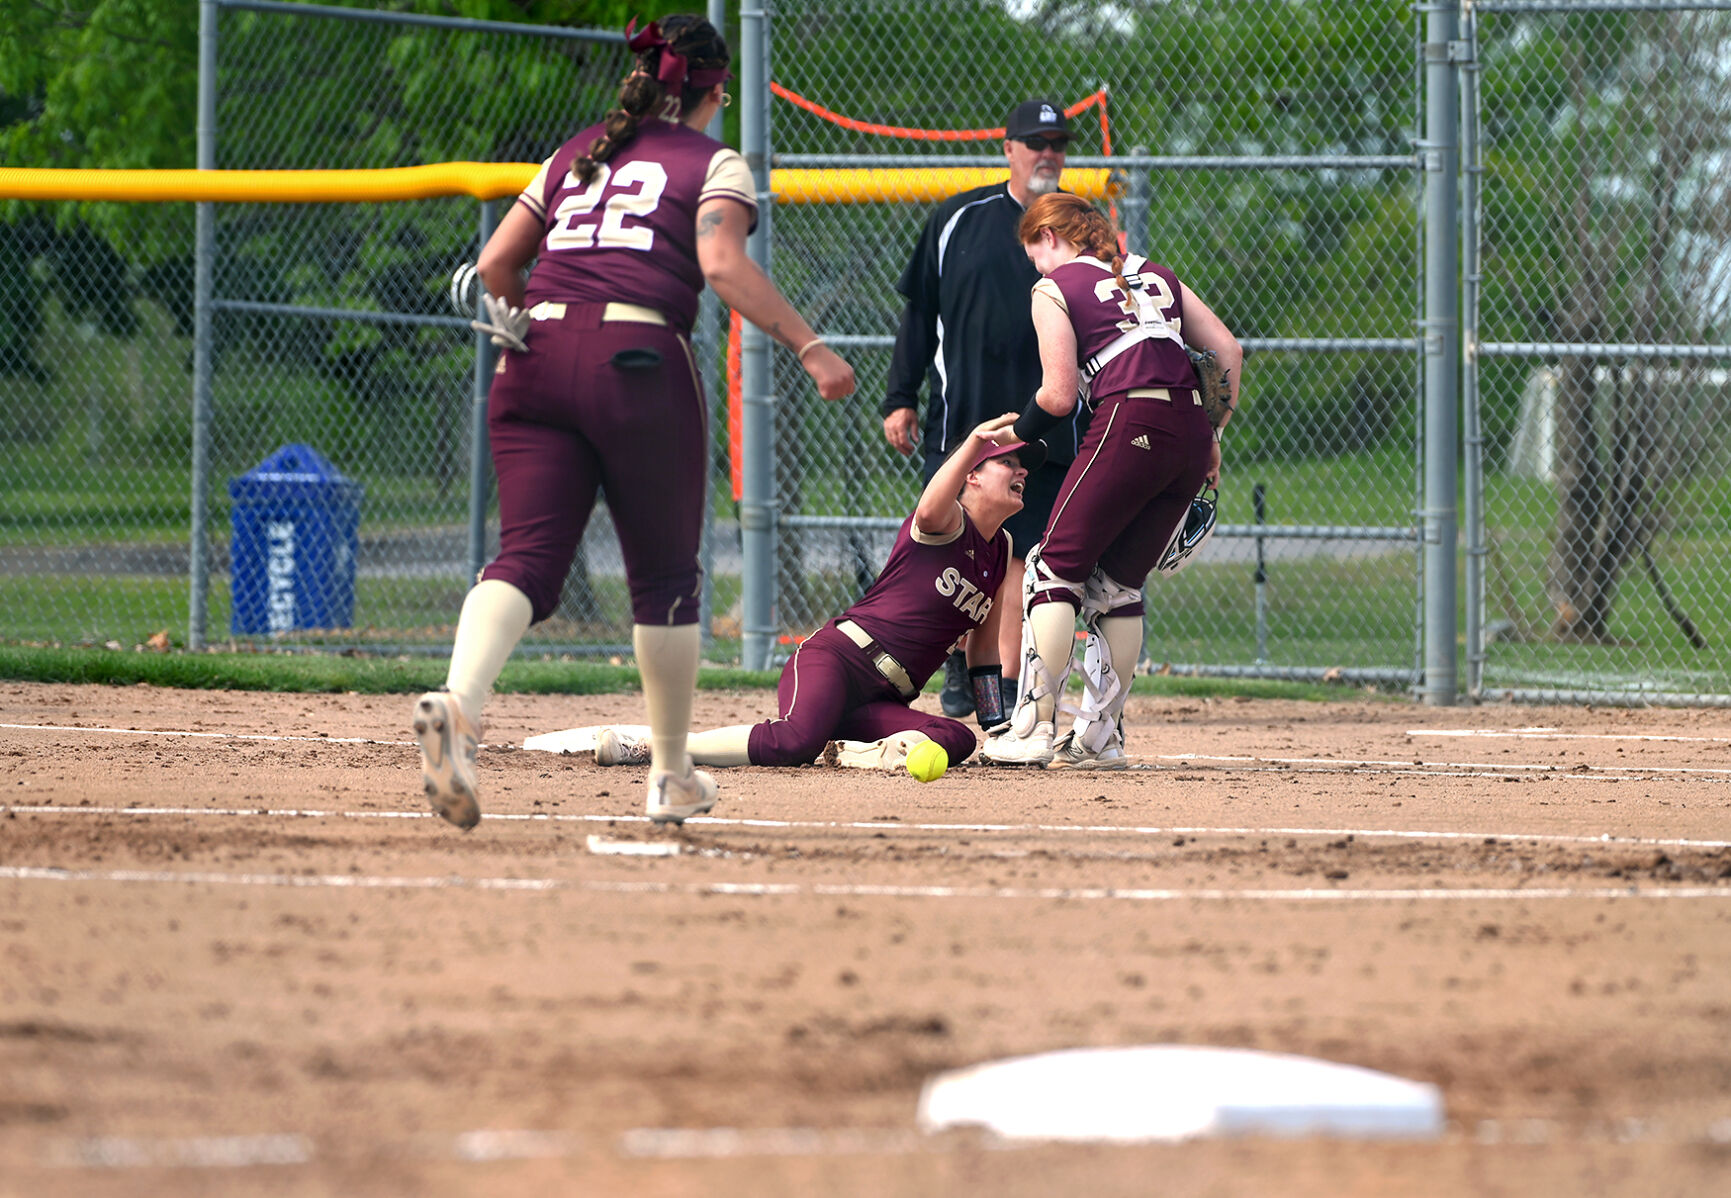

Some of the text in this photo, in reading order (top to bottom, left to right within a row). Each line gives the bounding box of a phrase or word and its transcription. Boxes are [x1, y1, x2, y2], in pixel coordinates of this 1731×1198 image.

[658, 95, 682, 124] 22
[546, 160, 668, 252] 22
[1094, 271, 1182, 336] 32
[268, 521, 296, 632] ECYCLE
